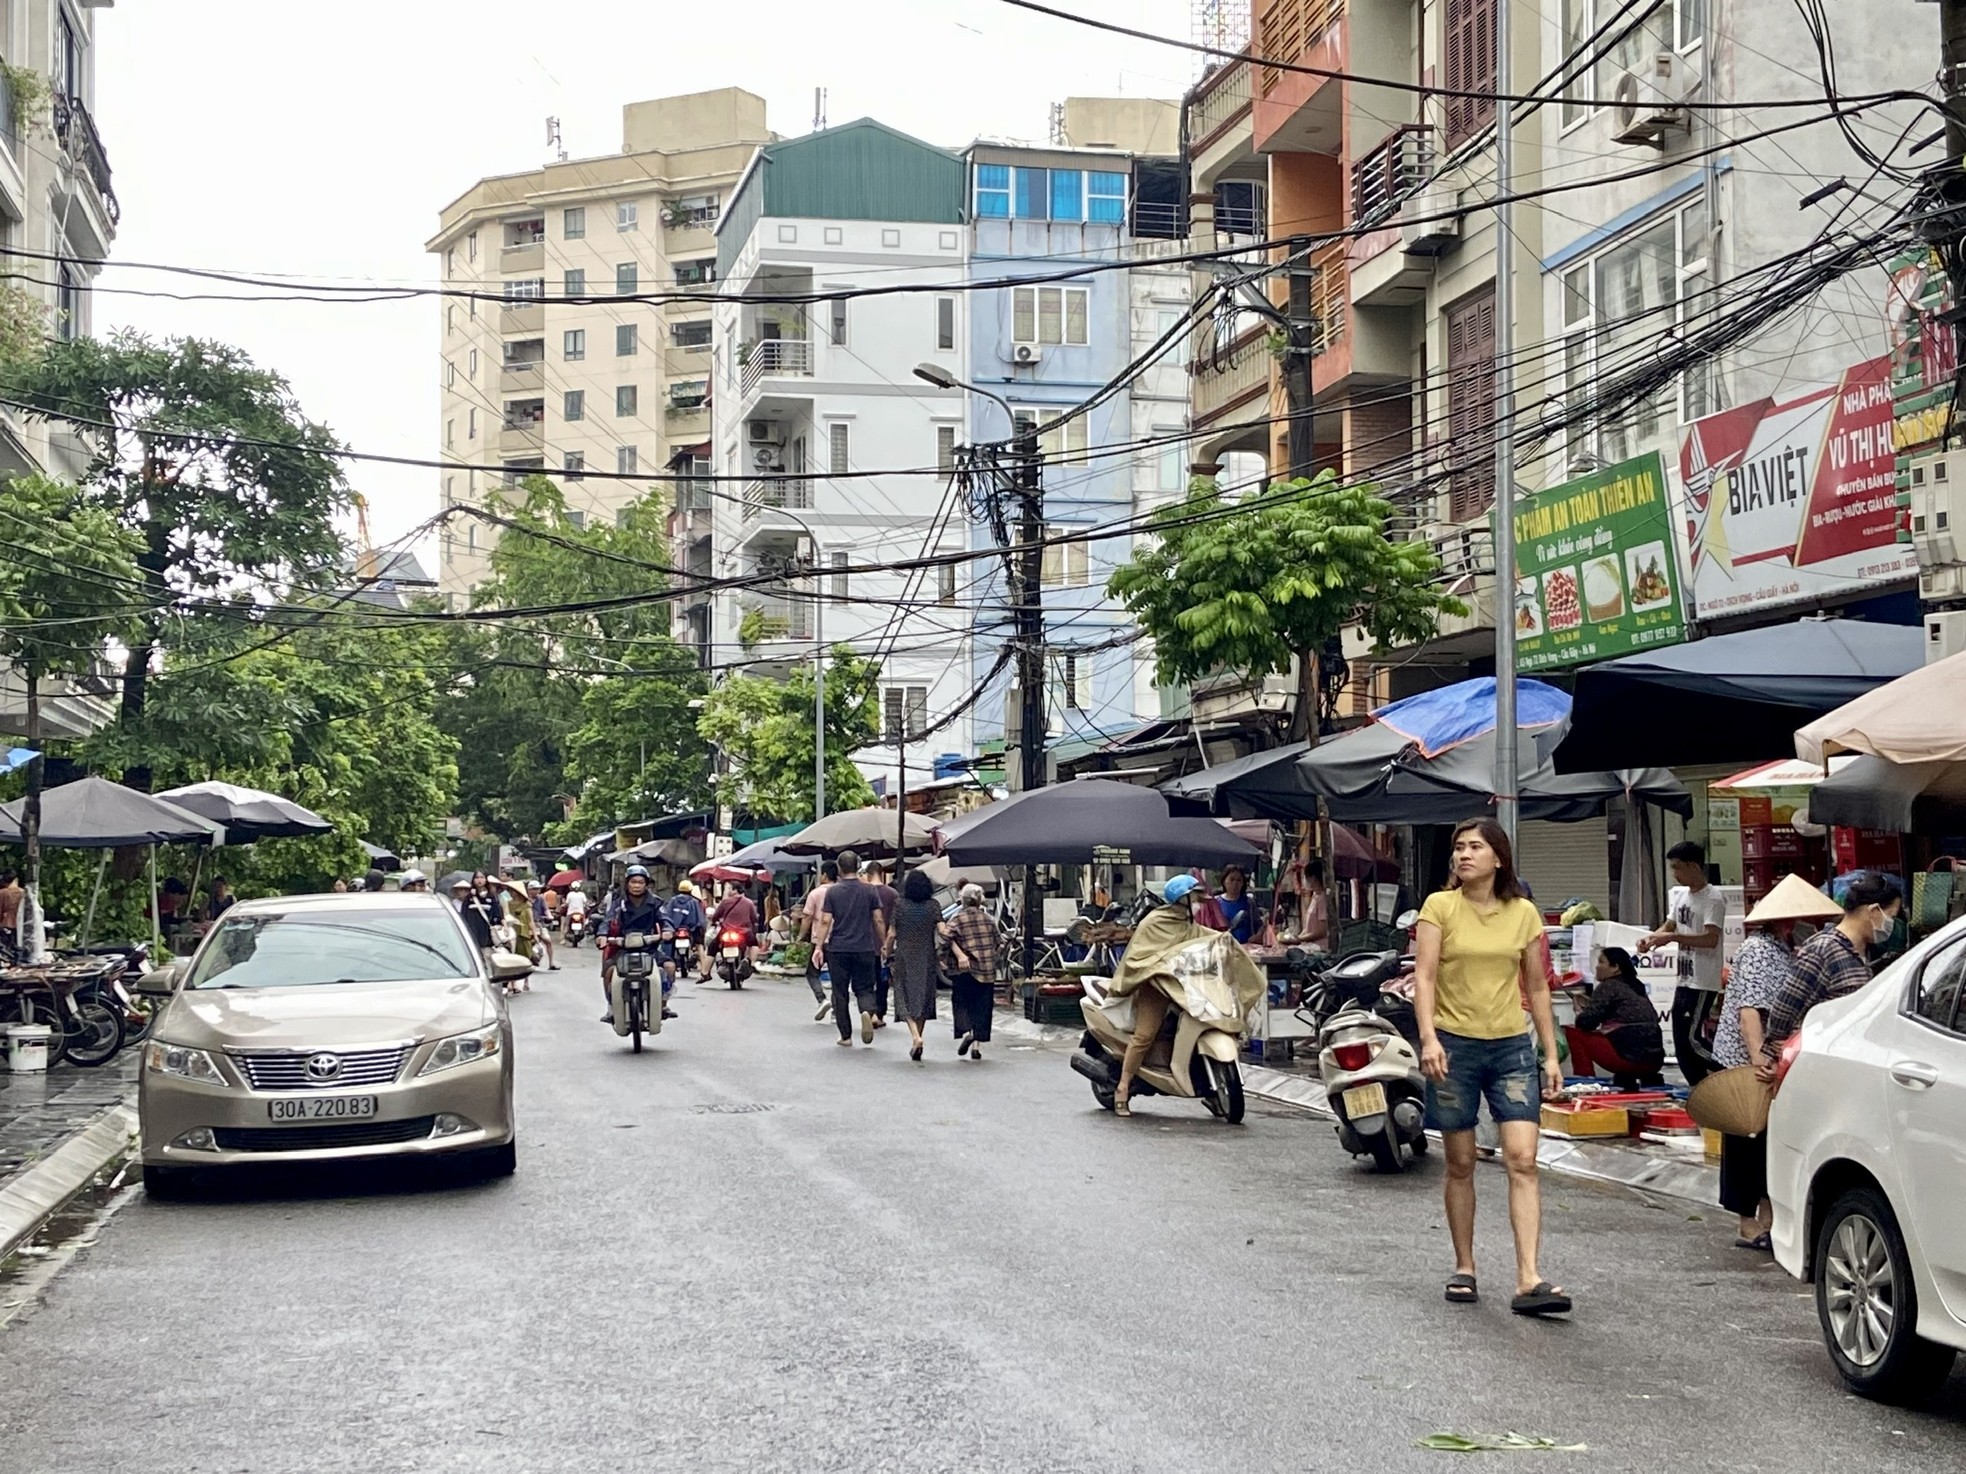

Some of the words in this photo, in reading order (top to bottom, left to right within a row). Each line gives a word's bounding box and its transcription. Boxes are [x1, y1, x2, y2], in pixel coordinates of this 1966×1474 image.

[1844, 384, 1867, 416] NHÀ
[1869, 376, 1892, 408] PHÂ
[1850, 426, 1874, 468] THỊ
[1884, 470, 1896, 486] BU
[1554, 498, 1570, 532] AN
[1569, 487, 1600, 526] TOÀN
[1600, 474, 1635, 516] THIÊN
[1635, 471, 1656, 505] AN
[275, 1098, 370, 1118] 30A-220.83
